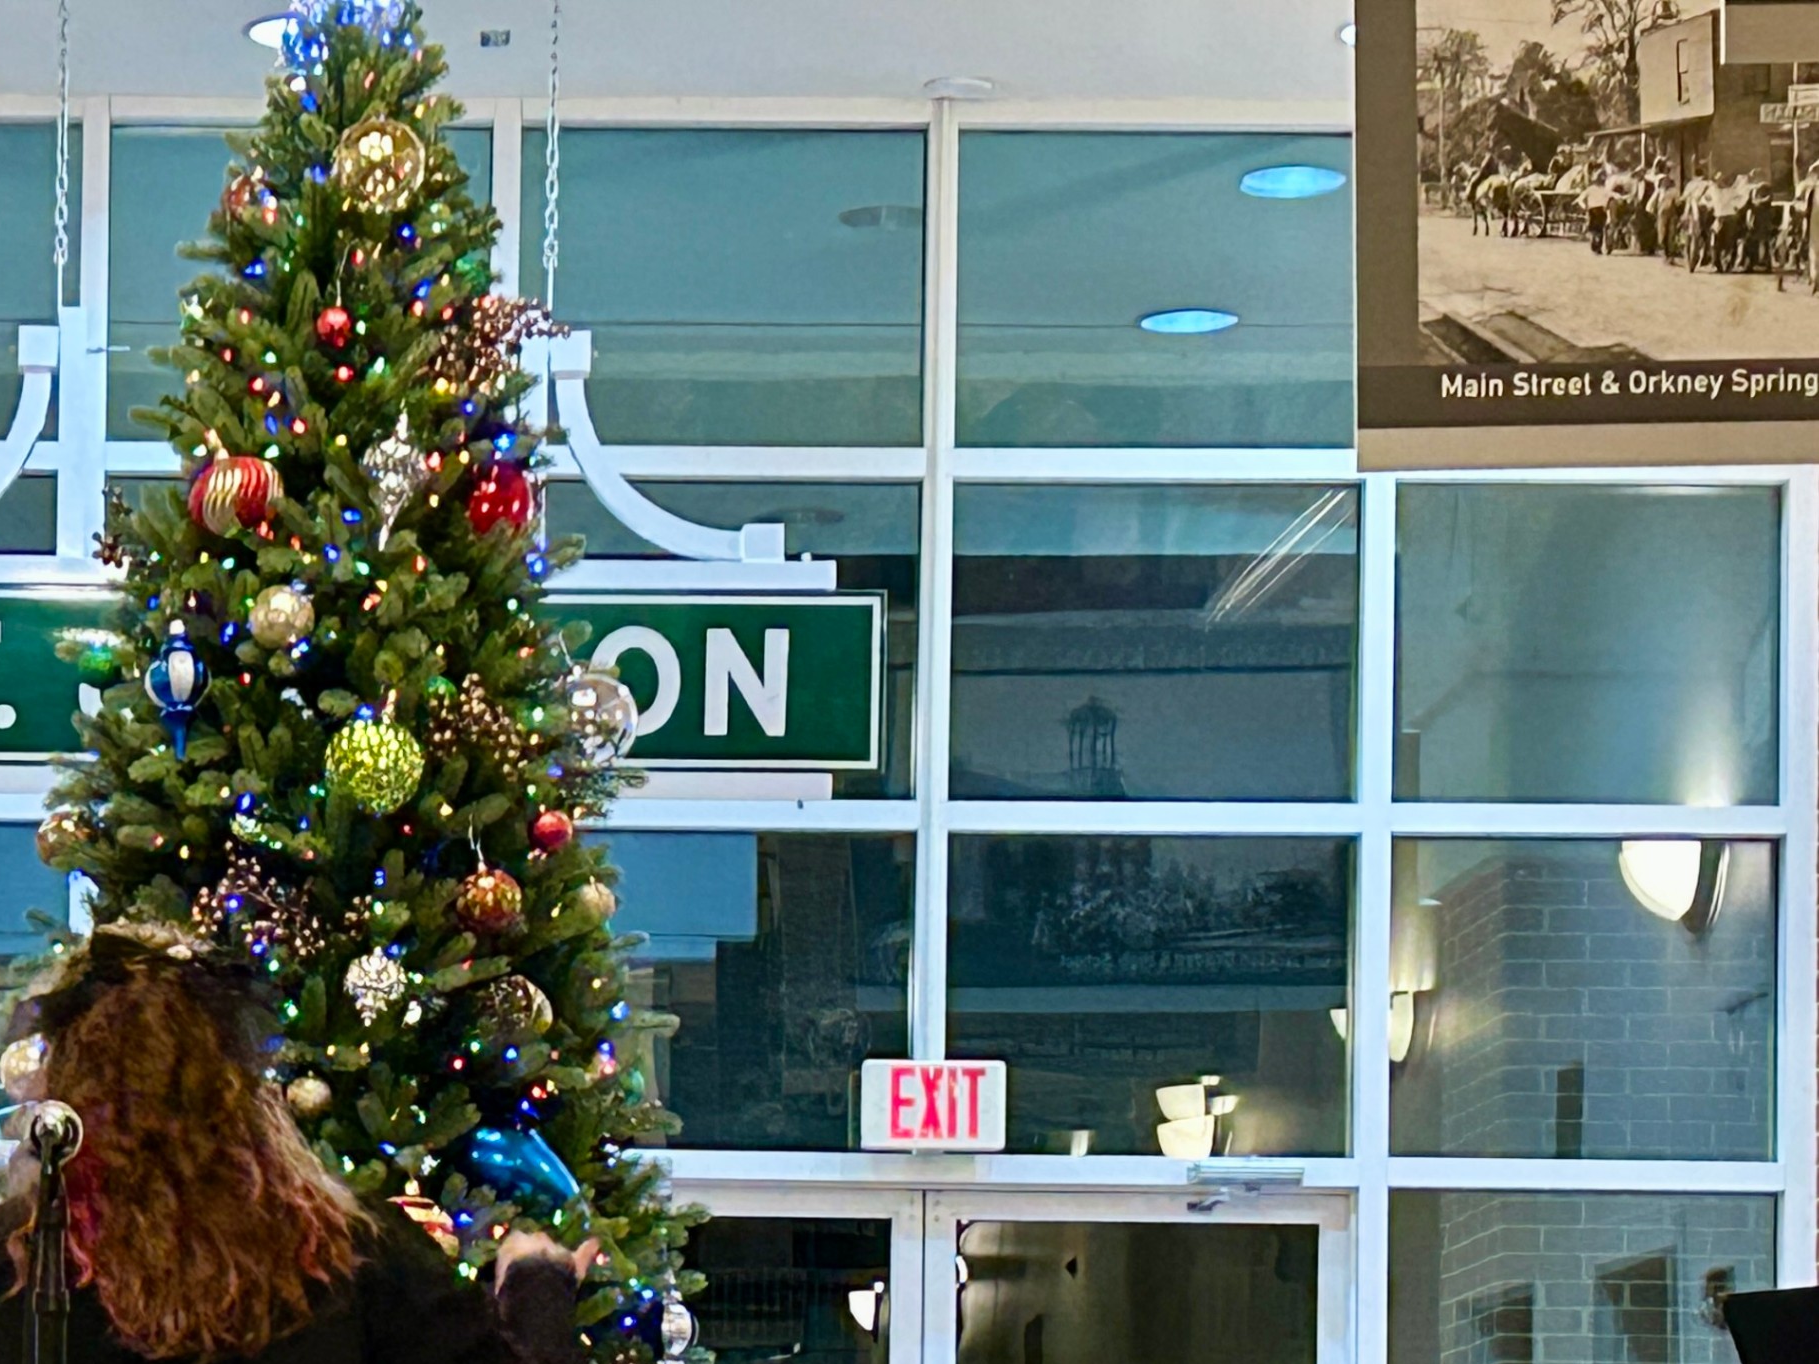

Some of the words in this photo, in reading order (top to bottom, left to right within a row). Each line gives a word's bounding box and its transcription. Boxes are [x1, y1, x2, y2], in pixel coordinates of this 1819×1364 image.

[1441, 371, 1504, 398] Main
[1512, 371, 1593, 397] Street
[1600, 369, 1621, 395] &
[1628, 369, 1725, 401] Orkney
[1731, 366, 1819, 399] Spring
[890, 1066, 987, 1139] EXIT
